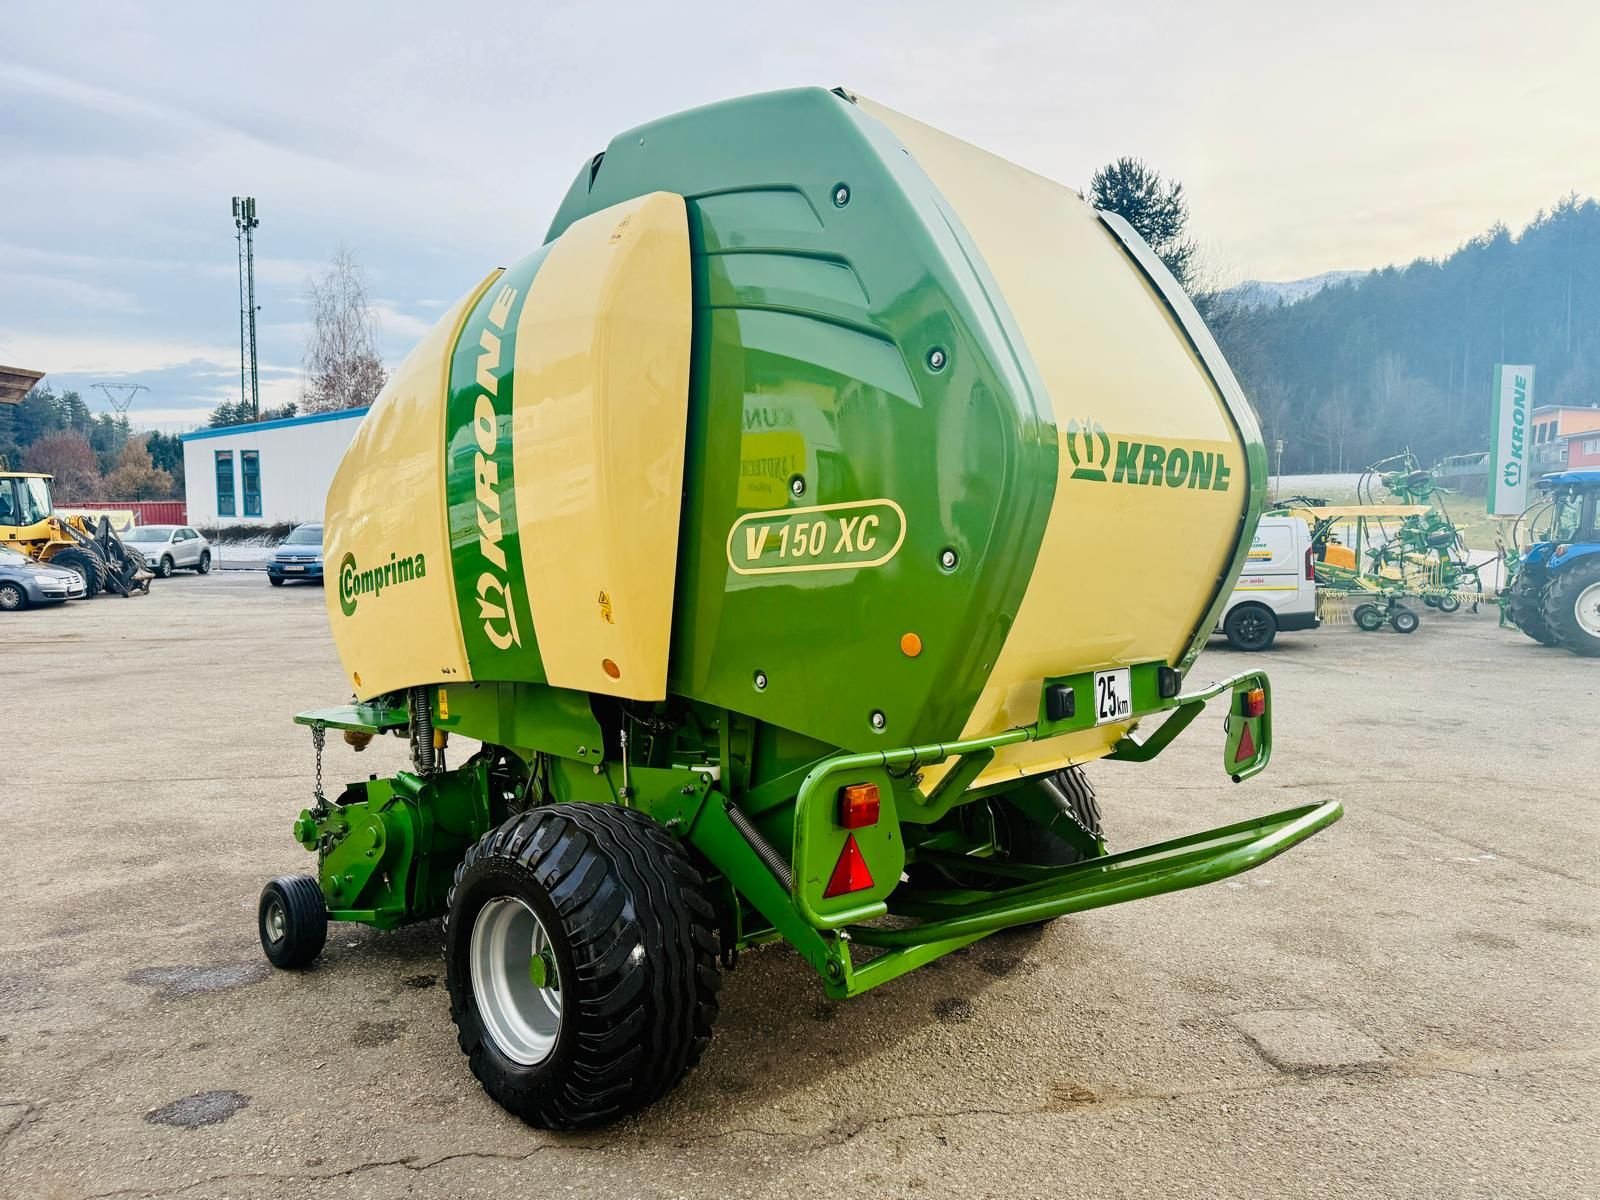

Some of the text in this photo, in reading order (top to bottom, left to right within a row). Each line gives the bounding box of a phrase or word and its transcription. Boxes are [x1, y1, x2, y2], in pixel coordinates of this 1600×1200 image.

[473, 284, 518, 571] KRONE
[1511, 375, 1527, 460] KRONE
[1112, 441, 1232, 491] KRONE
[66, 527, 86, 544] VOLVO
[745, 515, 880, 560] V 150 XC
[339, 551, 426, 616] Comprima
[1097, 675, 1116, 719] 25
